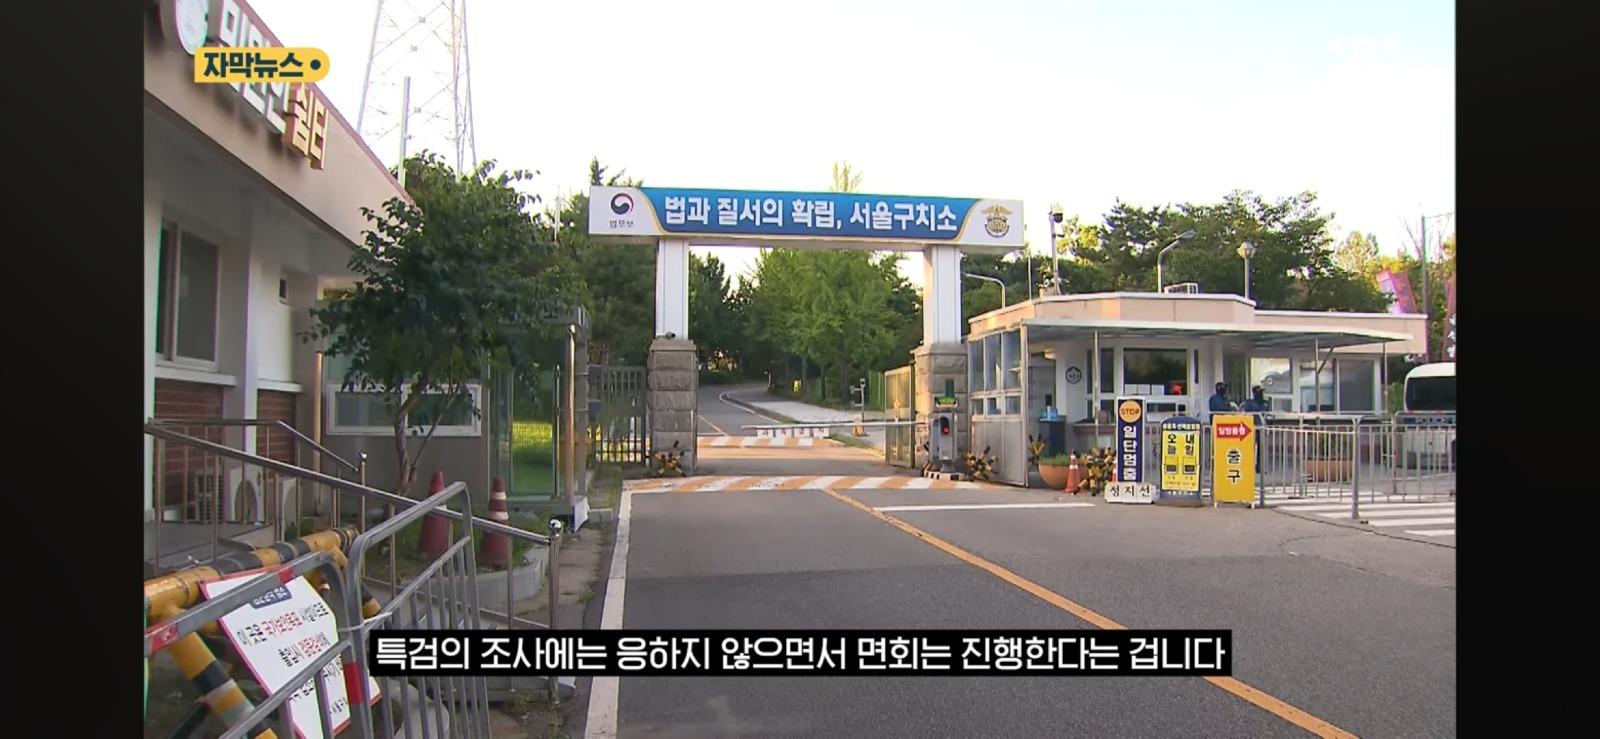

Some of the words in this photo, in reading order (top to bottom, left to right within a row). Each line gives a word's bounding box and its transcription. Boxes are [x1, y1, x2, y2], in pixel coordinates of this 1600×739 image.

[609, 219, 634, 229] 법무부
[664, 196, 711, 226] 법과
[717, 198, 784, 228] 질서의
[791, 199, 842, 230] 확립,
[849, 200, 958, 232] 서울구치소
[1124, 426, 1137, 481] 일단멈춤
[1167, 434, 1177, 454] 오늘
[1185, 433, 1195, 456] 내일
[1227, 449, 1241, 484] 출구
